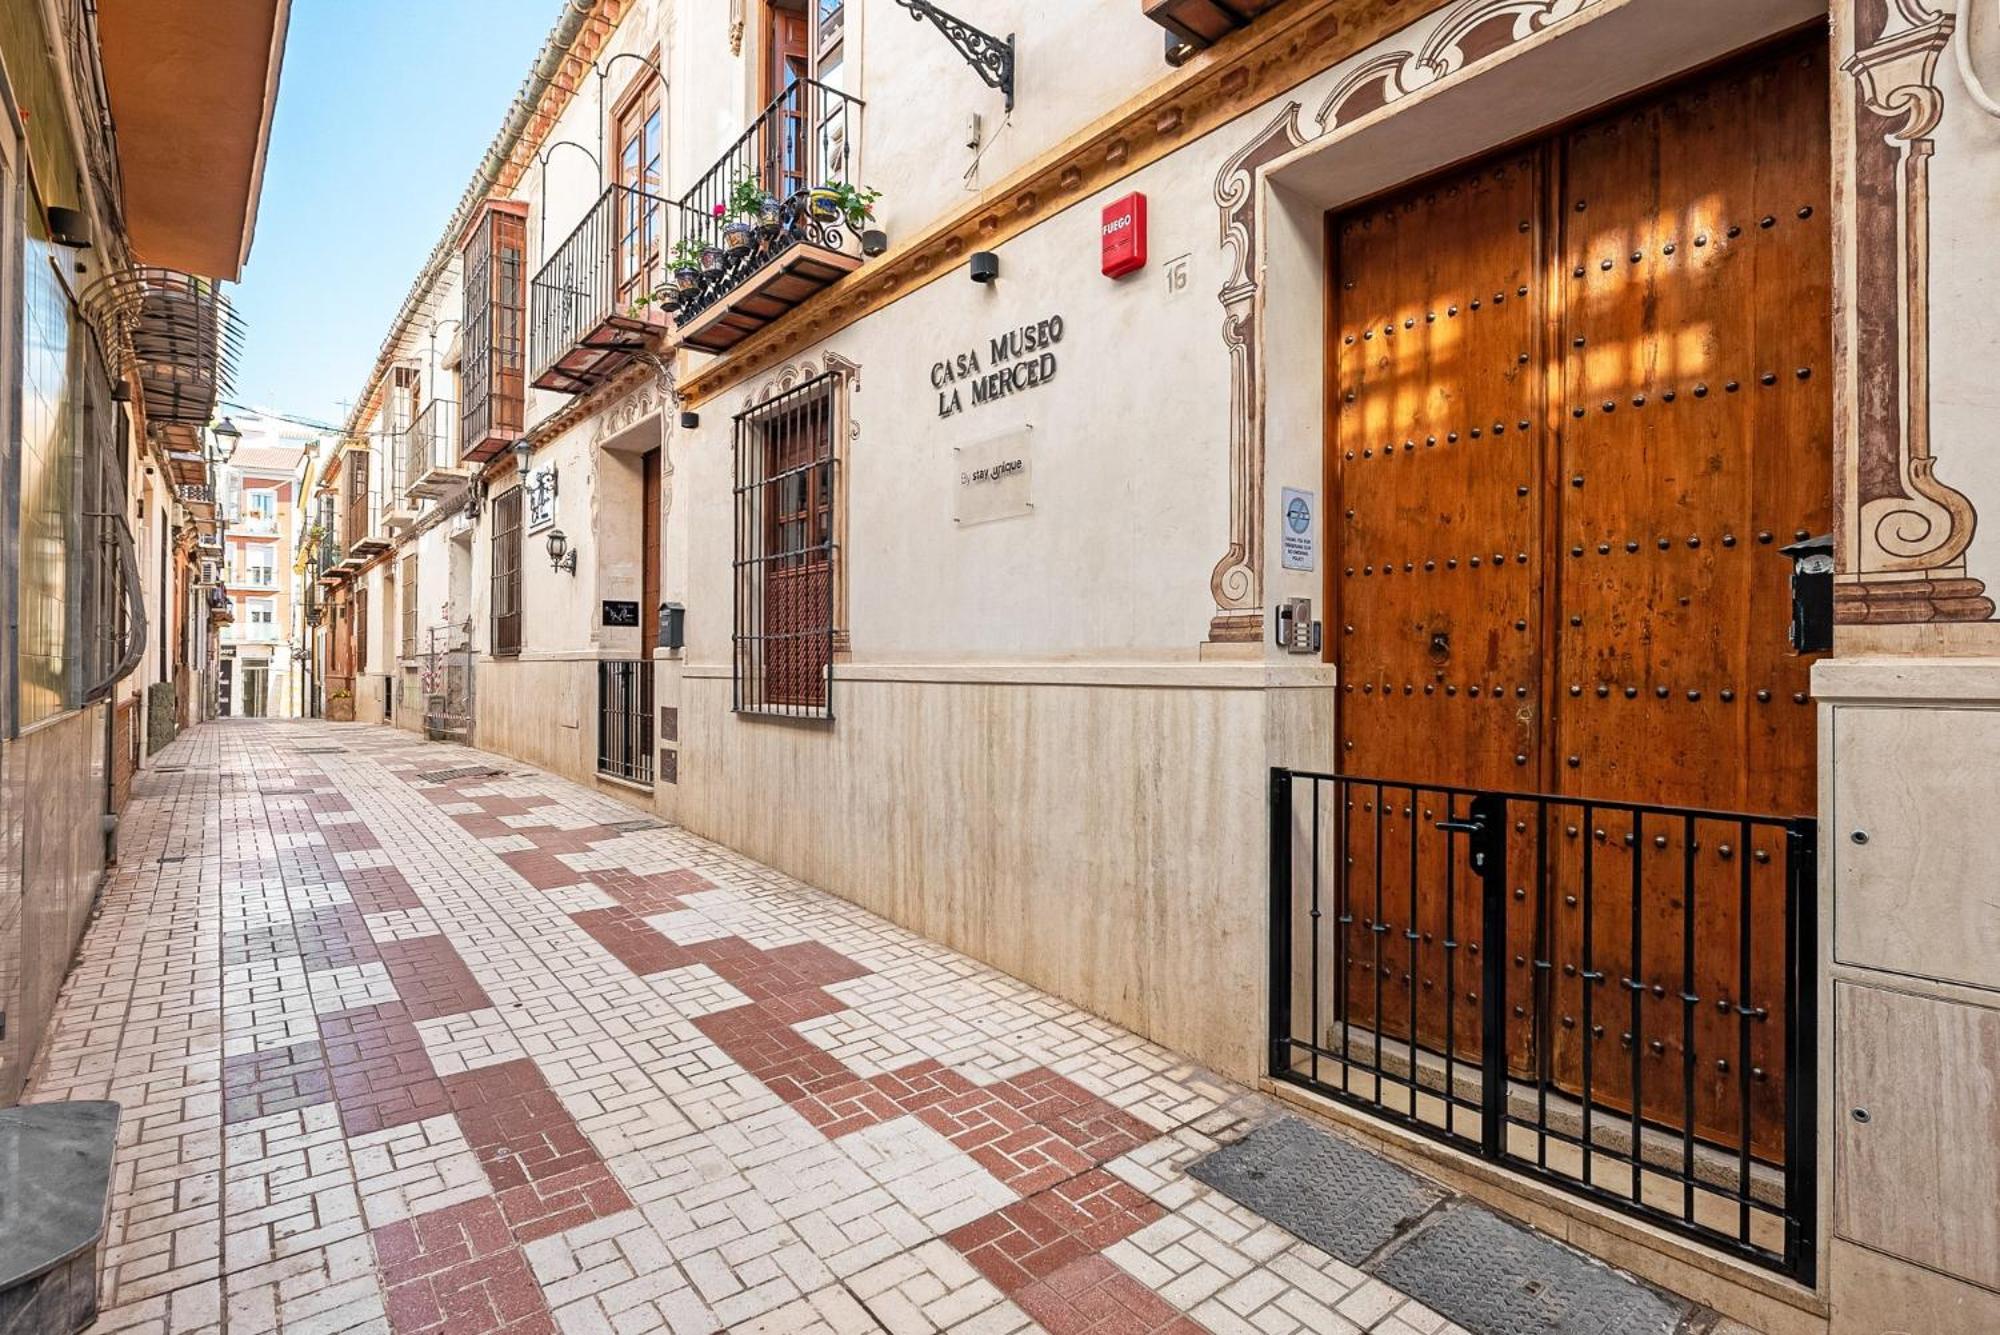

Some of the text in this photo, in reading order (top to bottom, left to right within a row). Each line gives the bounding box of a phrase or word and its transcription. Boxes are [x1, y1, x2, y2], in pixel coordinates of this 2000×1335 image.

[1102, 214, 1131, 235] FUEGO
[930, 315, 1063, 389] CASA MUSEO
[938, 352, 1057, 418] LA MERCED
[972, 468, 989, 481] stay
[990, 460, 1022, 480] unique
